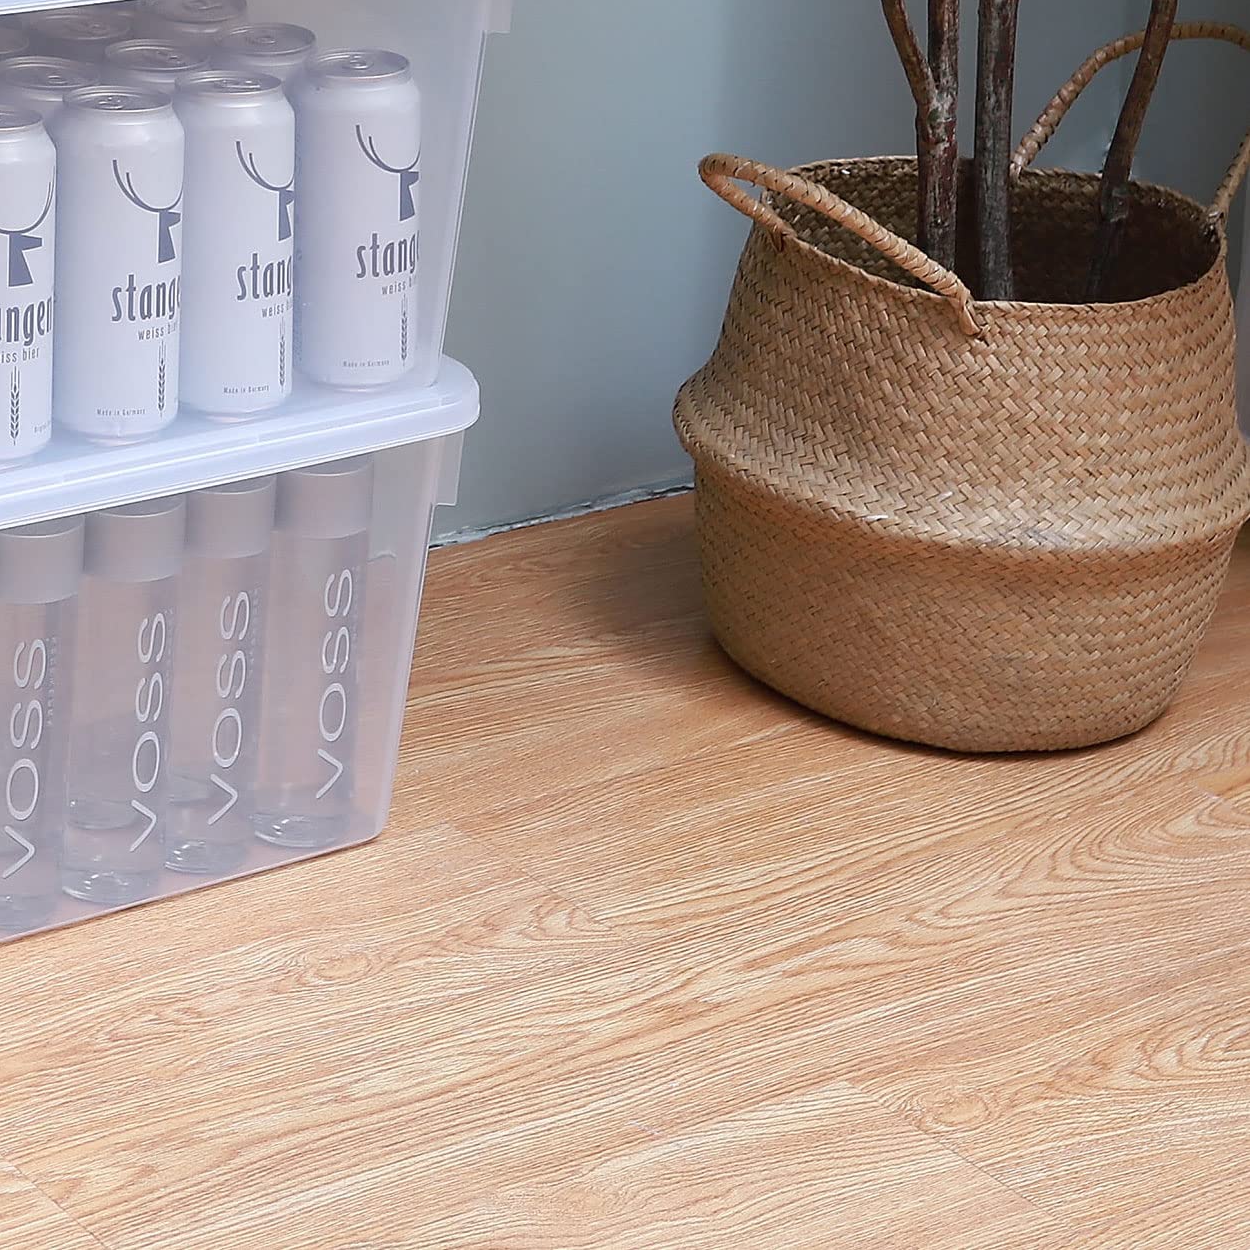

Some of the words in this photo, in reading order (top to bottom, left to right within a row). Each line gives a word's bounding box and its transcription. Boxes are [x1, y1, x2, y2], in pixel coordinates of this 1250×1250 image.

[261, 303, 285, 318] weiss
[356, 230, 420, 279] stang
[381, 282, 406, 295] weiss
[137, 326, 165, 341] weiss
[129, 613, 166, 852] VOSS
[208, 591, 250, 826] VOSS
[316, 569, 353, 799] VOSS
[2, 639, 47, 879] VOSS
